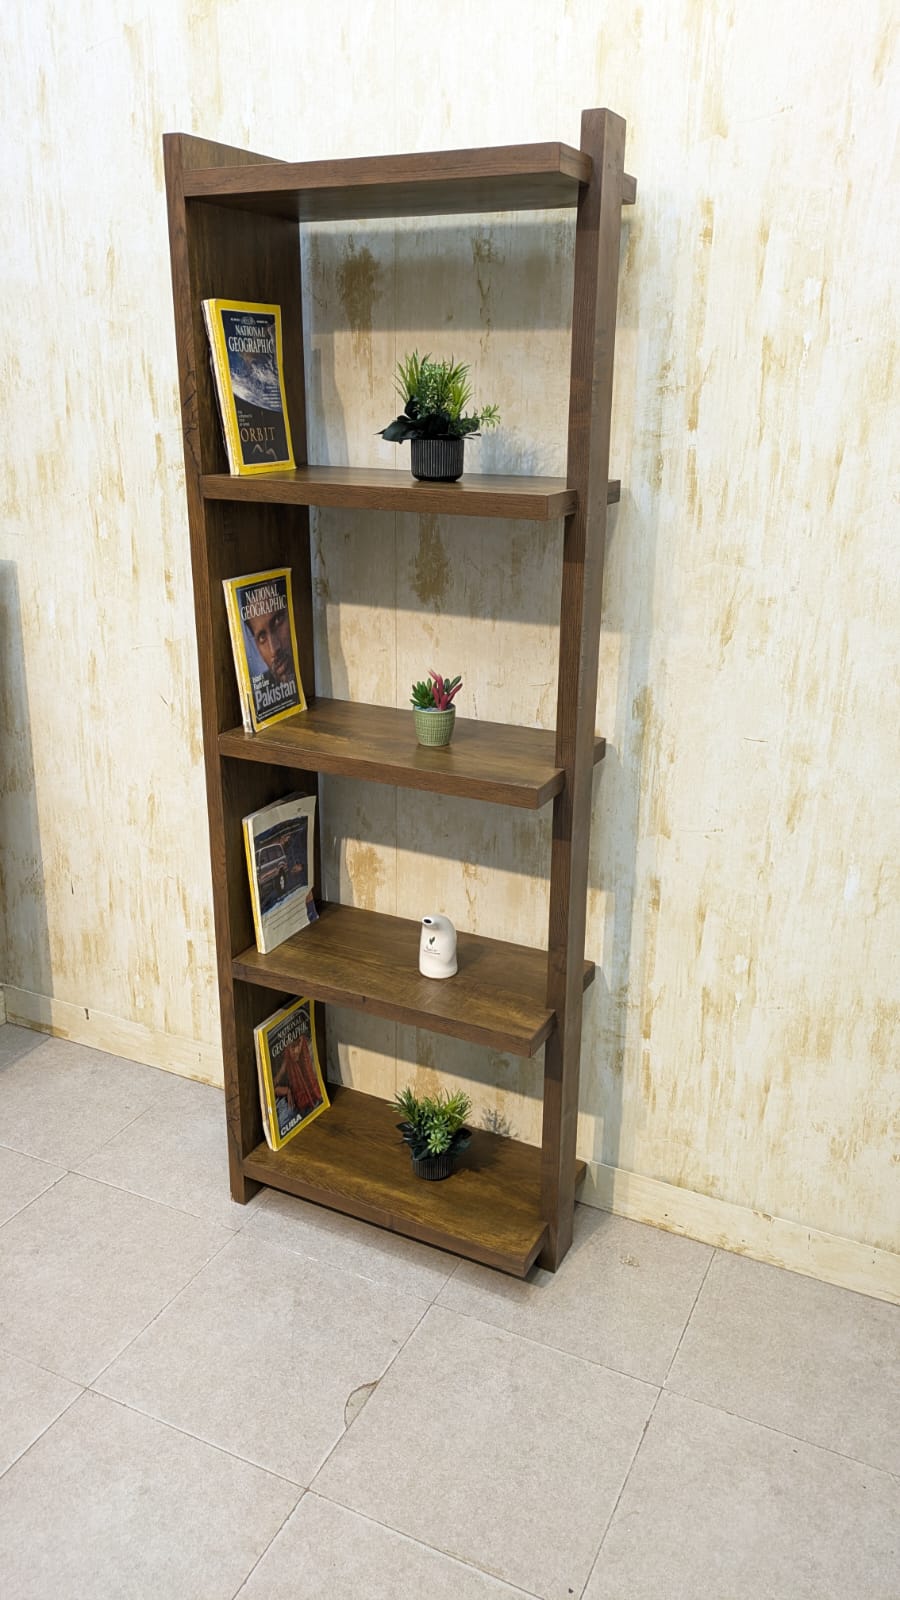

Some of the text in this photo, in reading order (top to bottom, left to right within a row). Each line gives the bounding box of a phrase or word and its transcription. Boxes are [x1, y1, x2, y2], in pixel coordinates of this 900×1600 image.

[235, 325, 266, 338] NATIONAL
[228, 336, 275, 353] GEOGRAPHIC
[240, 426, 276, 442] ORBIT
[245, 583, 280, 604] NATIONAL
[240, 594, 287, 620] GEOGRAPHIC
[254, 679, 297, 711] Pakistan
[271, 1020, 310, 1058] GEOGRAPHIC
[280, 1113, 303, 1136] CUBA
